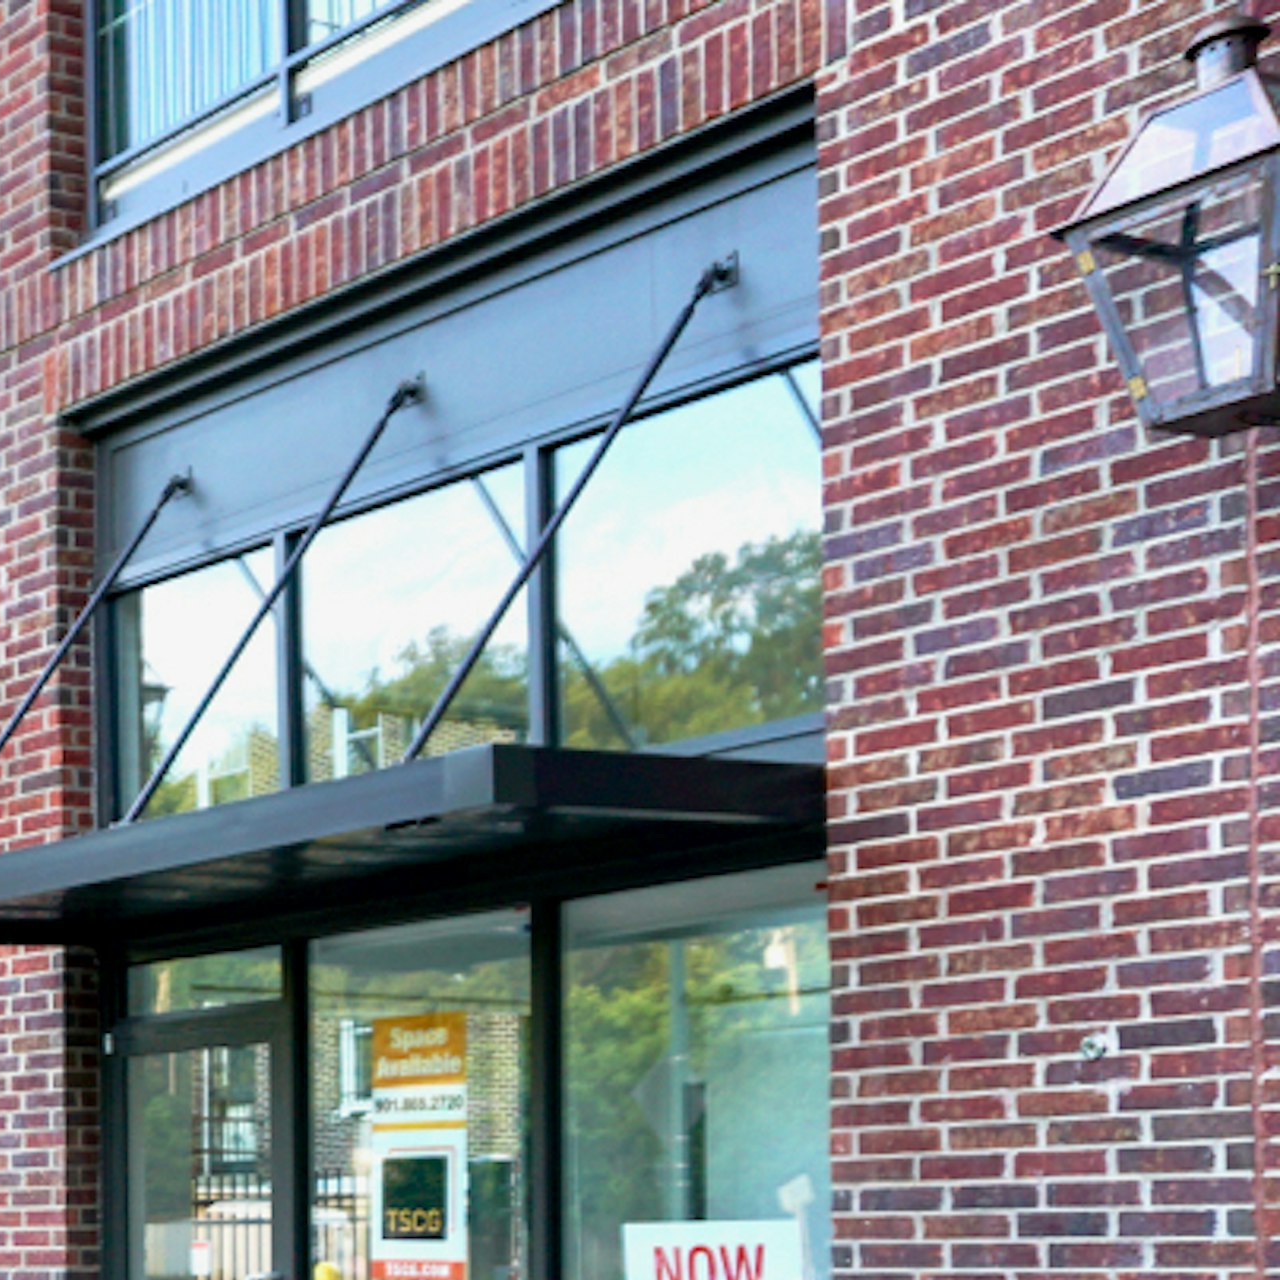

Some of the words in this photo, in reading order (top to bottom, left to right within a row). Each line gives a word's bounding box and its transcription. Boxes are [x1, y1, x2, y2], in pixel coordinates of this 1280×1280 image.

[388, 1025, 449, 1050] Space
[376, 1052, 462, 1079] Available
[386, 1208, 443, 1233] TSCG
